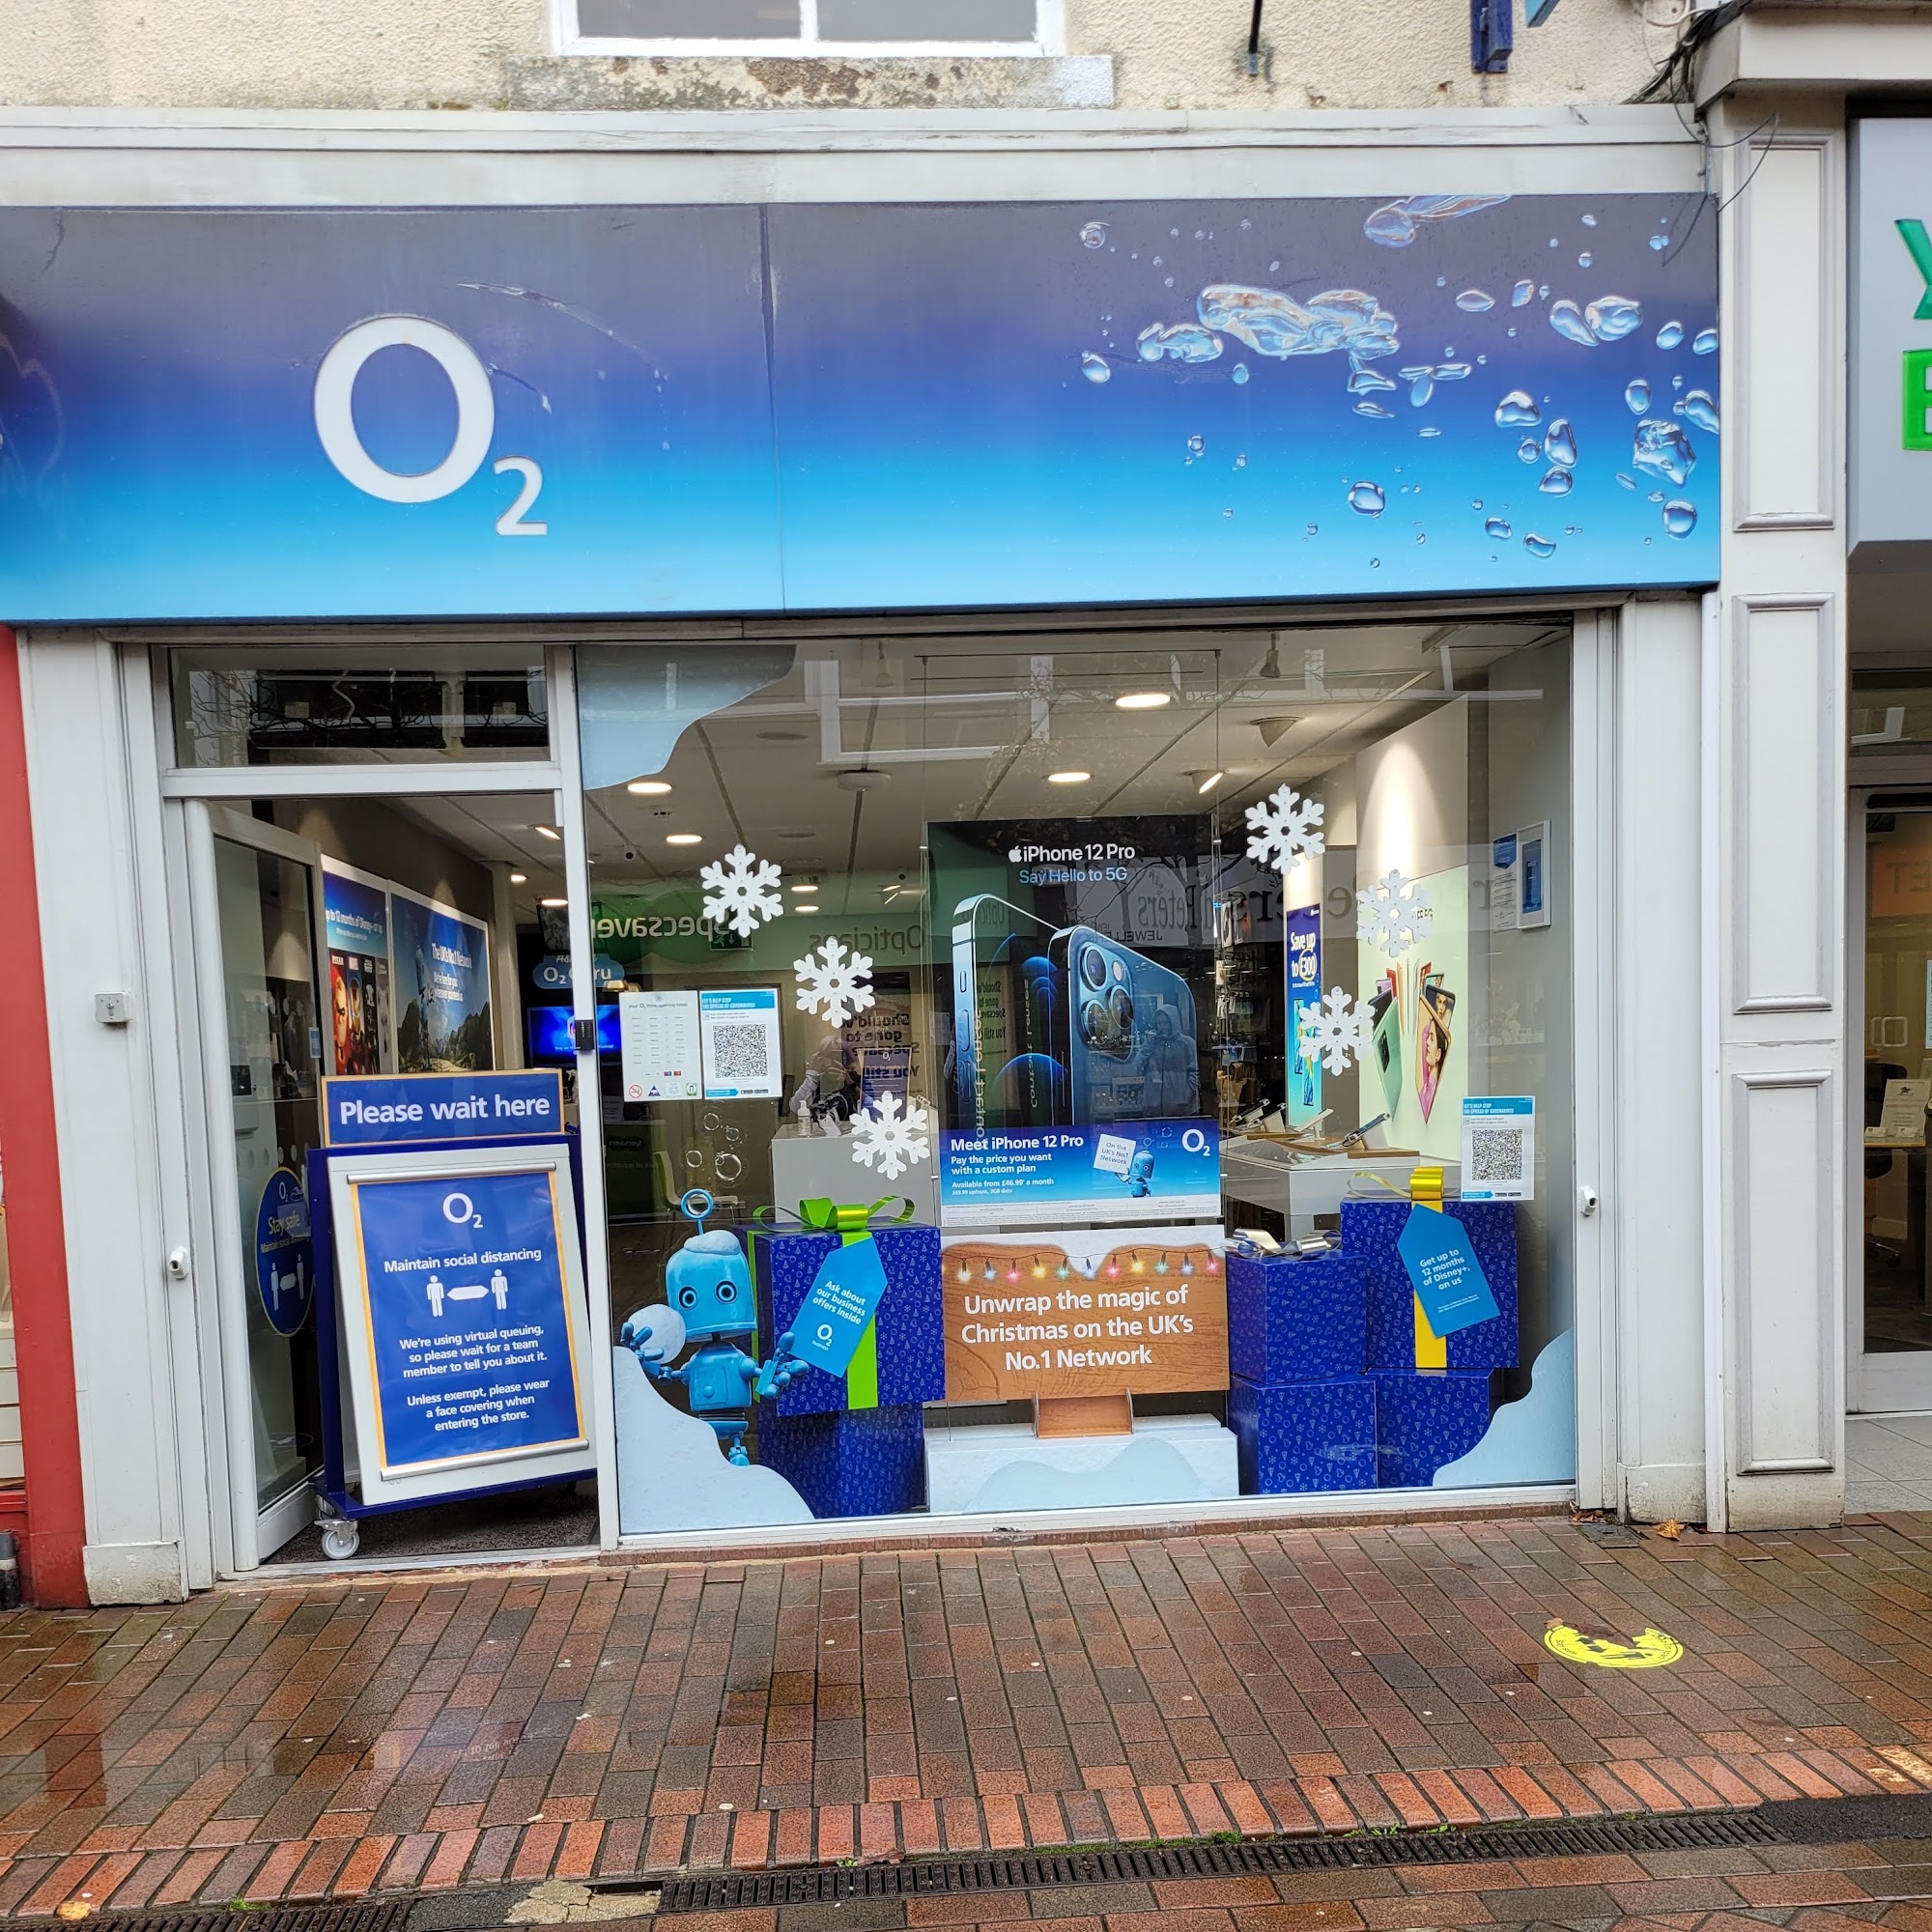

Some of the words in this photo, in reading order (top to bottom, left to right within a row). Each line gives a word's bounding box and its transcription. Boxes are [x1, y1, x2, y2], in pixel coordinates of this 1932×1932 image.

[314, 313, 548, 536] O2
[1023, 845, 1083, 863] iPhone
[1085, 843, 1103, 861] 12
[1107, 843, 1136, 860] Pro
[1019, 869, 1046, 886] Say
[1048, 867, 1086, 883] Hello
[1089, 868, 1103, 882] to
[1105, 867, 1128, 881] 5G
[1291, 932, 1306, 952] Save
[1306, 932, 1316, 952] up
[543, 966, 567, 984] O2
[1291, 960, 1299, 978] to
[340, 1099, 424, 1125] Please
[430, 1095, 489, 1121] wait
[495, 1094, 551, 1118] here
[951, 1136, 988, 1151] Meet
[991, 1136, 1040, 1150] iPhone
[1042, 1135, 1058, 1149] 12
[1061, 1135, 1084, 1148] Pro
[1181, 1129, 1211, 1157] O2
[951, 1155, 967, 1166] Pay
[968, 1155, 984, 1164] the
[985, 1154, 1008, 1166] price
[1009, 1154, 1027, 1165] you
[1028, 1153, 1052, 1162] want
[952, 1165, 973, 1175] with
[981, 1165, 1015, 1175] custom
[1016, 1164, 1037, 1175] plan
[952, 1180, 982, 1189] Available
[983, 1179, 1001, 1188] from
[269, 1215, 285, 1236] Stay
[286, 1209, 301, 1230] safe
[442, 1192, 484, 1229] O2
[384, 1258, 441, 1273] Maintain
[443, 1252, 478, 1267] social
[480, 1248, 542, 1265] distancing
[1419, 1256, 1436, 1268] Get
[1436, 1253, 1449, 1264] up
[1449, 1248, 1460, 1259] to
[1422, 1267, 1433, 1278] 12
[1433, 1256, 1465, 1273] months
[825, 1280, 841, 1293] Ask
[840, 1287, 867, 1306] about
[1423, 1276, 1434, 1287] of
[1438, 1281, 1451, 1291] on
[1452, 1277, 1463, 1286] us
[812, 1296, 837, 1314] offers
[837, 1308, 862, 1325] inside
[816, 1288, 831, 1299] our
[833, 1293, 867, 1317] business
[964, 1293, 1053, 1316] Unwrap
[1056, 1290, 1093, 1310] the
[1097, 1287, 1161, 1313] magic
[1165, 1284, 1189, 1305] of
[400, 1336, 432, 1350] We're
[434, 1334, 463, 1348] using
[465, 1328, 497, 1343] virtual
[500, 1323, 545, 1343] queuing,
[817, 1323, 834, 1347] O2
[961, 1321, 1068, 1344] Christmas
[1073, 1321, 1101, 1339] on
[1105, 1316, 1144, 1337] the
[1148, 1314, 1194, 1335] UK's
[410, 1352, 422, 1363] so
[424, 1348, 459, 1365] please
[460, 1345, 484, 1357] wait
[485, 1341, 502, 1354] for
[503, 1343, 511, 1351] a
[512, 1339, 539, 1350] team
[1005, 1350, 1051, 1371] No.1
[1057, 1345, 1153, 1369] Network
[403, 1363, 448, 1378] member
[450, 1362, 463, 1373] to
[464, 1358, 481, 1371] tell
[483, 1358, 502, 1372] you
[504, 1353, 536, 1365] about
[537, 1351, 549, 1362] it.
[407, 1393, 442, 1407] Unless
[444, 1387, 487, 1405] exempt,
[489, 1382, 522, 1401] please
[524, 1379, 551, 1390] wear
[426, 1410, 434, 1419] a
[435, 1403, 458, 1417] face
[460, 1399, 503, 1416] covering
[504, 1395, 535, 1408] when
[435, 1416, 479, 1432] entering
[481, 1412, 499, 1424] the
[500, 1409, 530, 1422] store.
